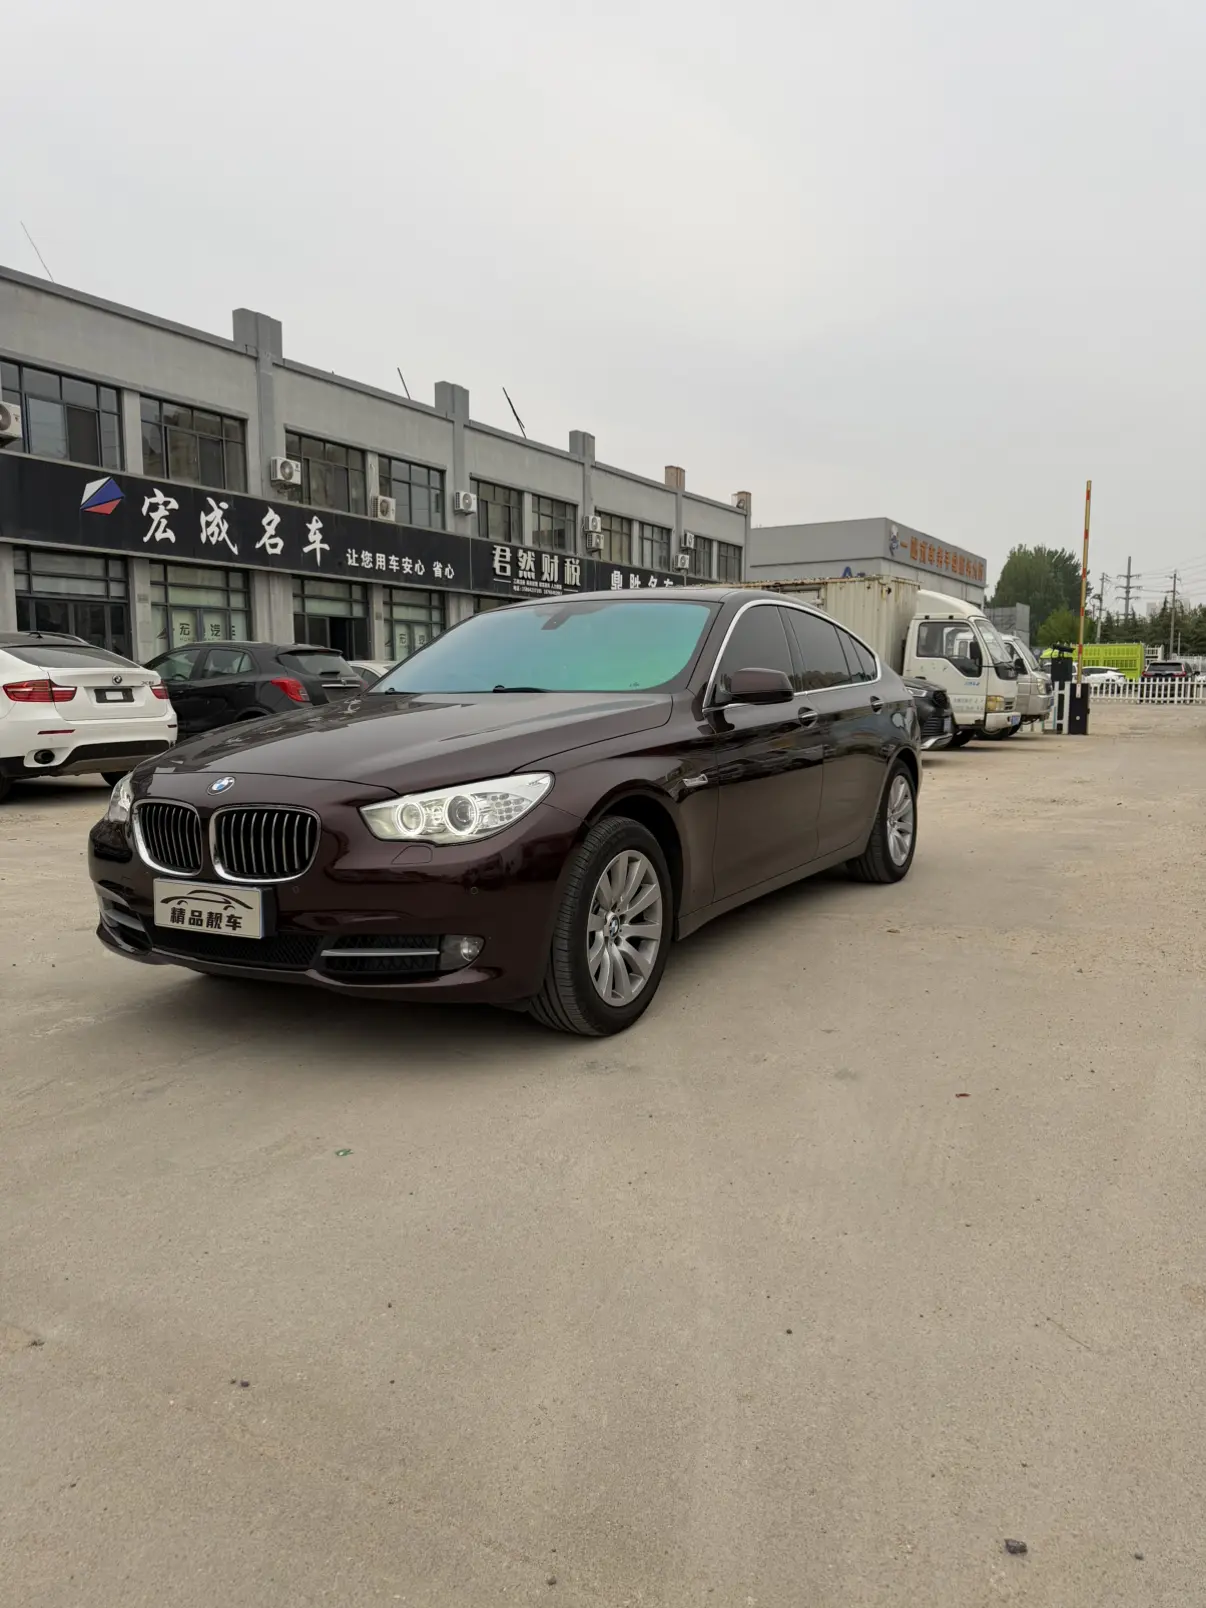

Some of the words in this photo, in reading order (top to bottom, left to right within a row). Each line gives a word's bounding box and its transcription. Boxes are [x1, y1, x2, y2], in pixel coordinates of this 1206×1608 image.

[141, 488, 331, 567] 宏成名车
[346, 548, 425, 575] 让您用车安心
[432, 560, 455, 579] 省心
[492, 544, 581, 586] 君然财税
[169, 906, 243, 931] 精品靓车
